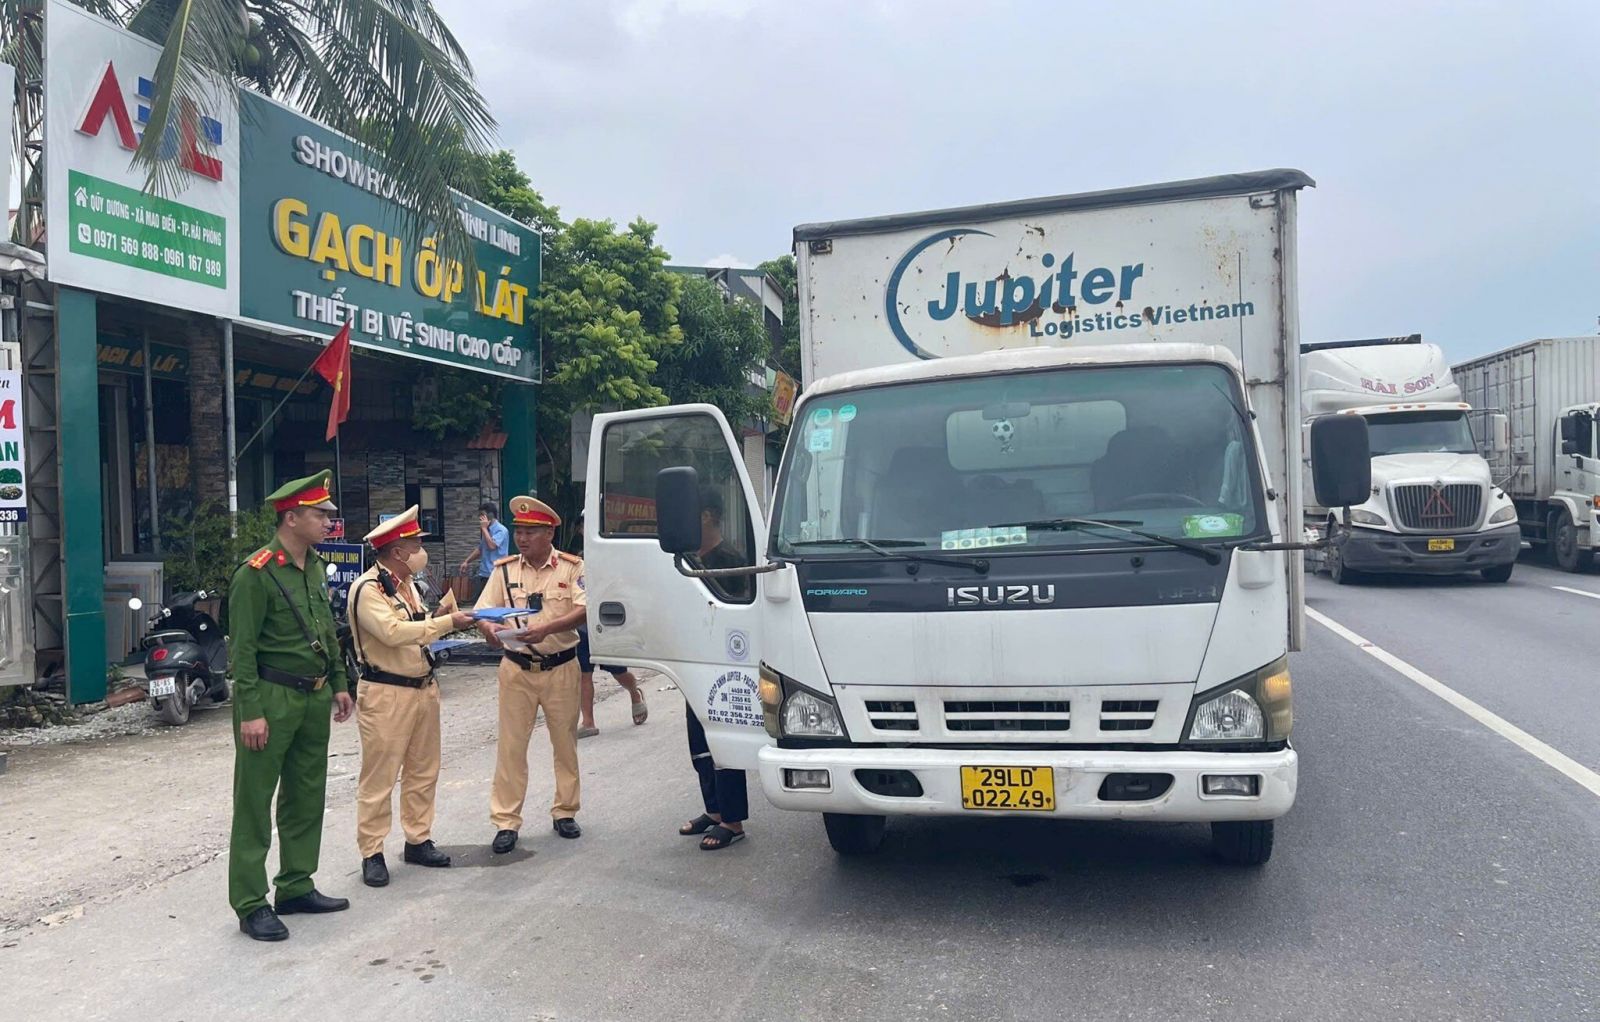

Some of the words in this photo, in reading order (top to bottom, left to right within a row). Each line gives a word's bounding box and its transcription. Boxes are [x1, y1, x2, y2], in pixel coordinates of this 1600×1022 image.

[93, 229, 117, 250] 0971
[121, 236, 138, 256] 569
[188, 254, 202, 272] 167
[205, 258, 221, 277] 989
[489, 225, 520, 256] LINH
[273, 198, 402, 288] GẠCH
[475, 265, 529, 326] LÁT
[927, 251, 1144, 327] Jupiter
[292, 287, 358, 330] THIẾT
[361, 309, 383, 342] BỊ
[387, 312, 413, 349] VỆ
[415, 322, 455, 352] SINH
[457, 333, 490, 361] CAO
[491, 336, 522, 367] CẤP
[1029, 311, 1142, 339] Logistics
[1147, 300, 1255, 326] Vietnam
[806, 588, 868, 596] FORWARD
[947, 584, 1055, 606] ISUZU
[980, 768, 1034, 787] 29LD
[972, 789, 1044, 808] 022.49
